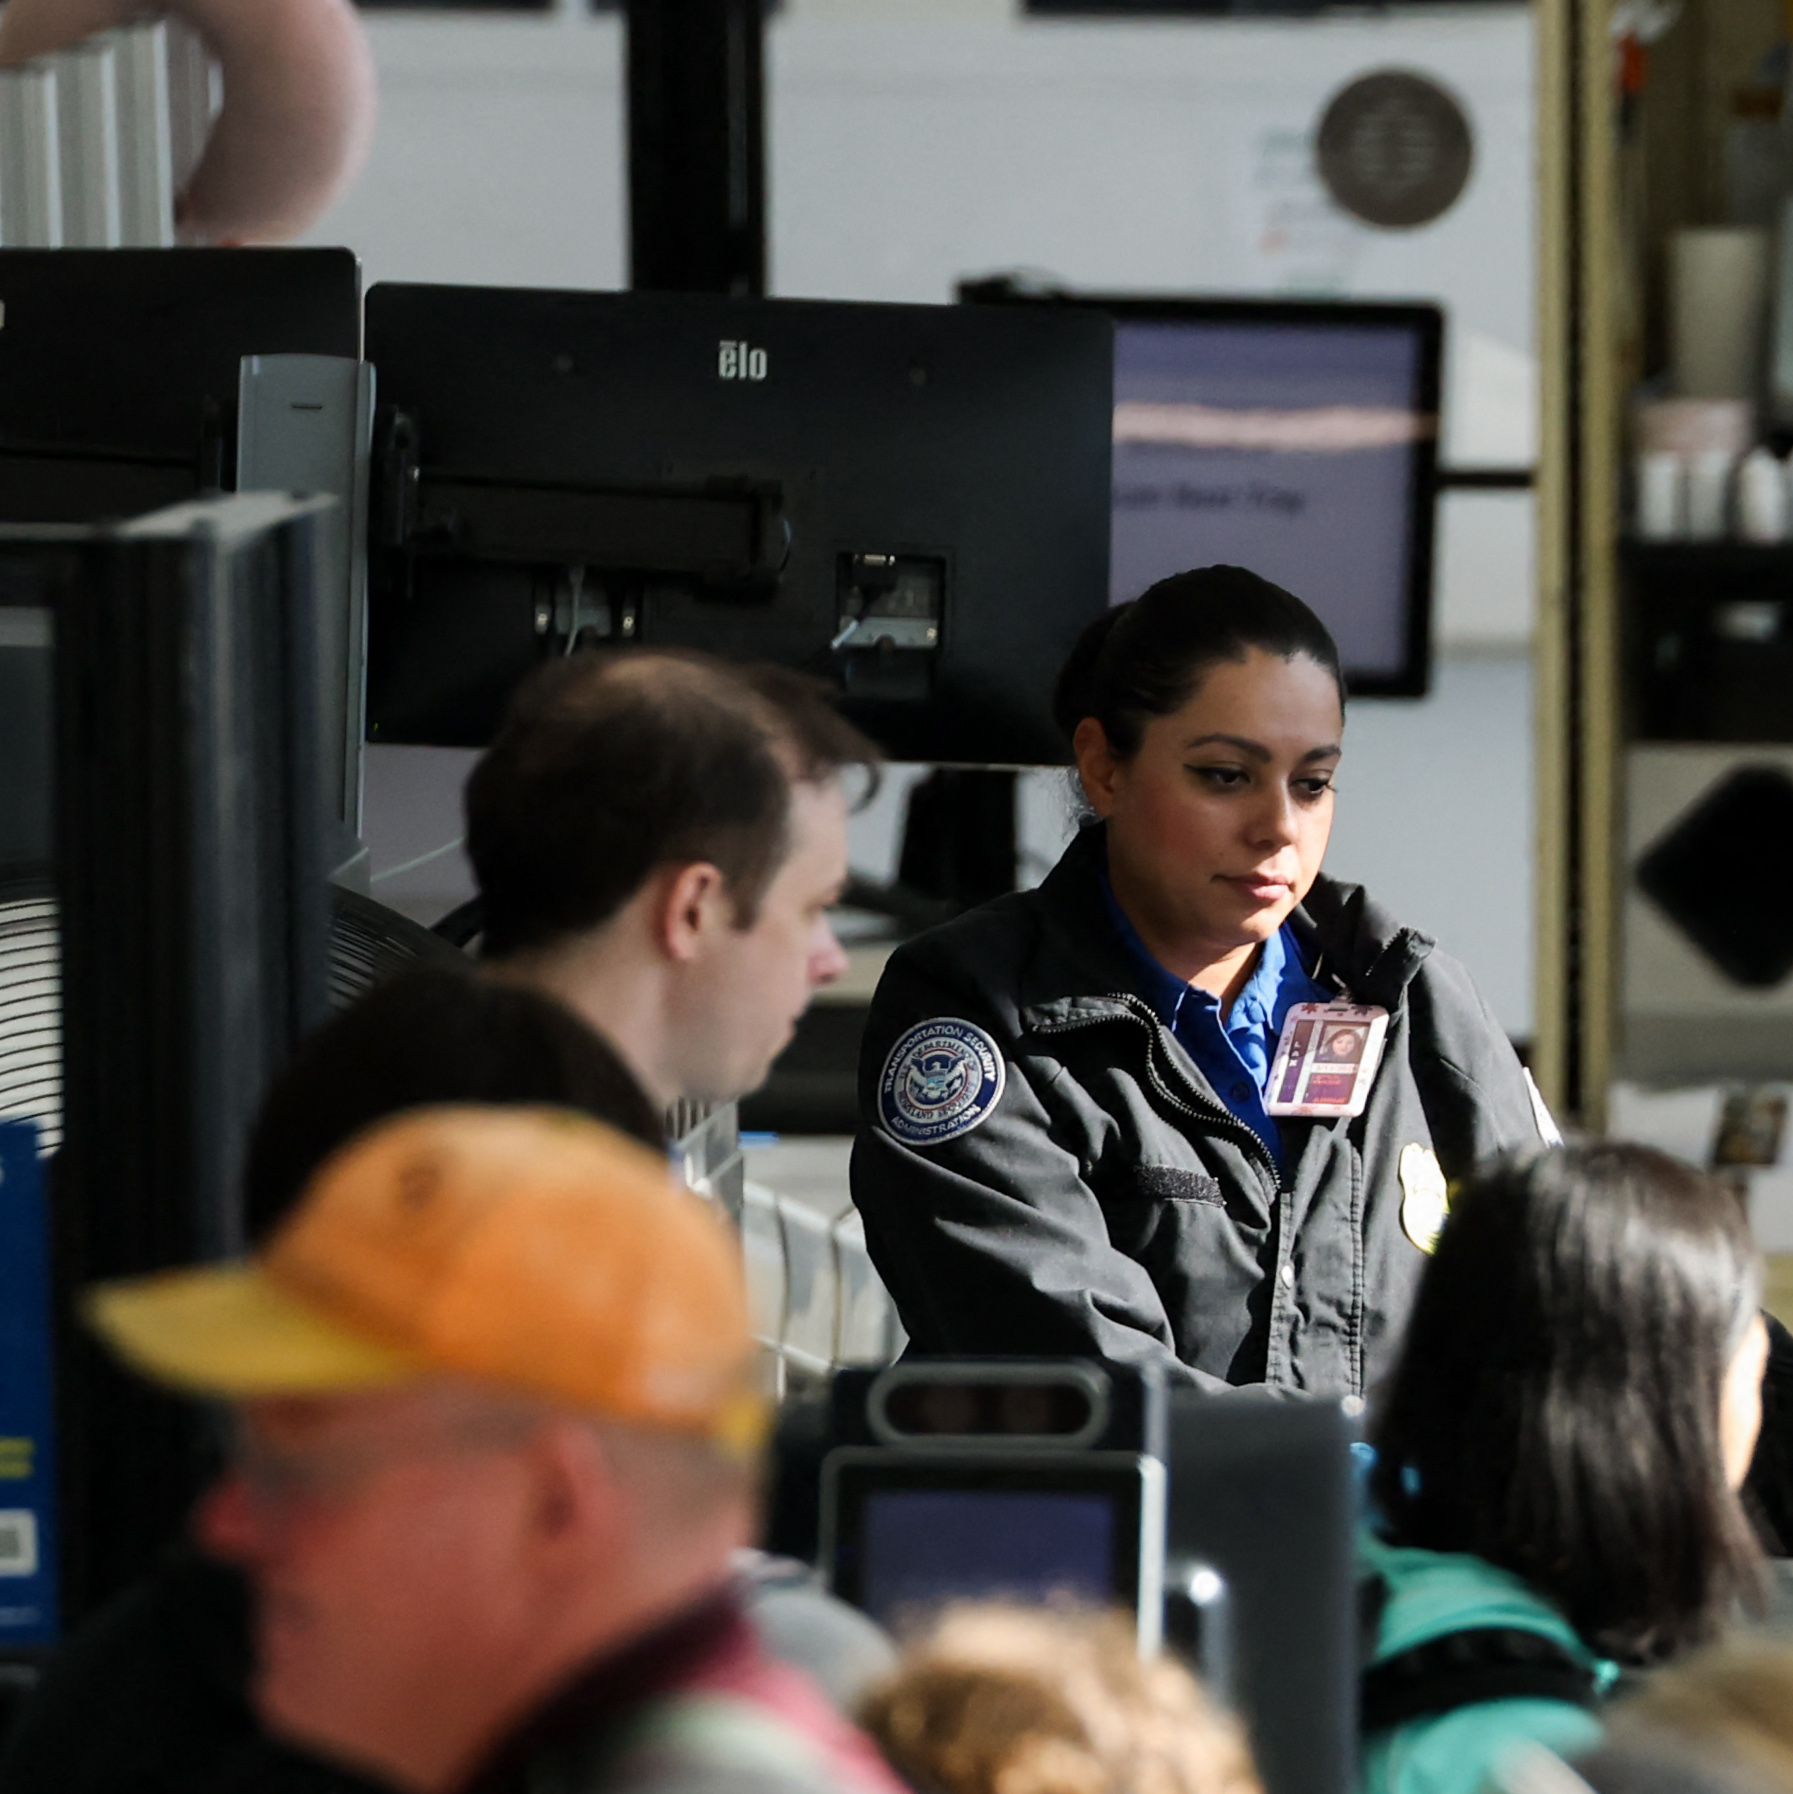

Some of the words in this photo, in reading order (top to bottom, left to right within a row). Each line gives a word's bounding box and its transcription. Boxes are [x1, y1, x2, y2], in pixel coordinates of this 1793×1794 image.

[884, 1025, 964, 1094] TRANSPORTATION
[963, 1032, 996, 1083] SECURITY
[891, 1104, 982, 1136] ADMINISTRATION
